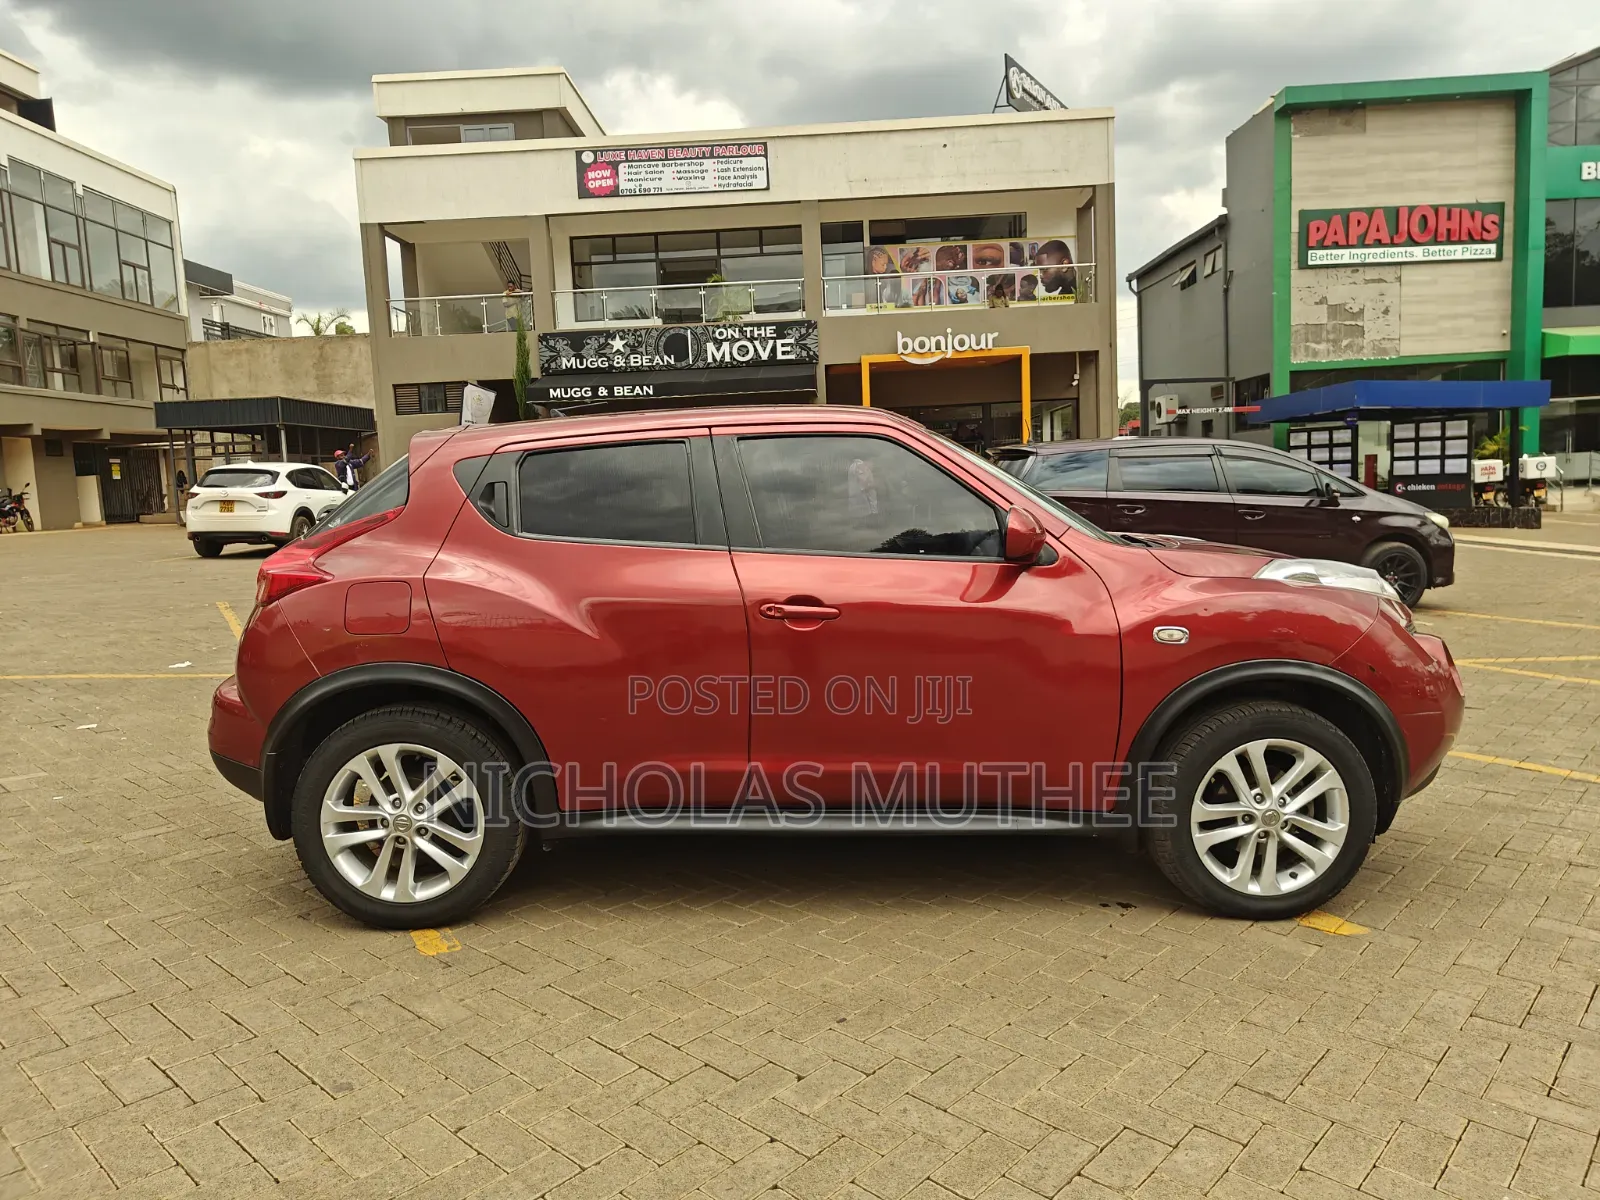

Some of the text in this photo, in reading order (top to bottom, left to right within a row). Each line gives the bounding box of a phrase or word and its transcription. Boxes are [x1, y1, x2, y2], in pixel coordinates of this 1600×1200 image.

[597, 145, 764, 162] LUXE HAVEN BEAUTY PARLOUR
[661, 161, 704, 169] Barbershop
[733, 165, 765, 173] Extensions
[1581, 162, 1600, 180] B
[588, 169, 611, 179] NOW
[733, 173, 758, 181] Analysis
[588, 178, 614, 188] OPEN
[620, 187, 637, 195] 0705
[1308, 204, 1500, 248] PAPA JOHNS
[1309, 246, 1496, 263] Better Ingredients. Better Pizza.
[715, 325, 777, 341] ON THE
[705, 337, 797, 363] MOVE
[896, 327, 999, 359] bonjour
[561, 354, 676, 370] MUGG & BEAN
[549, 385, 654, 399] MUGG & BEAN
